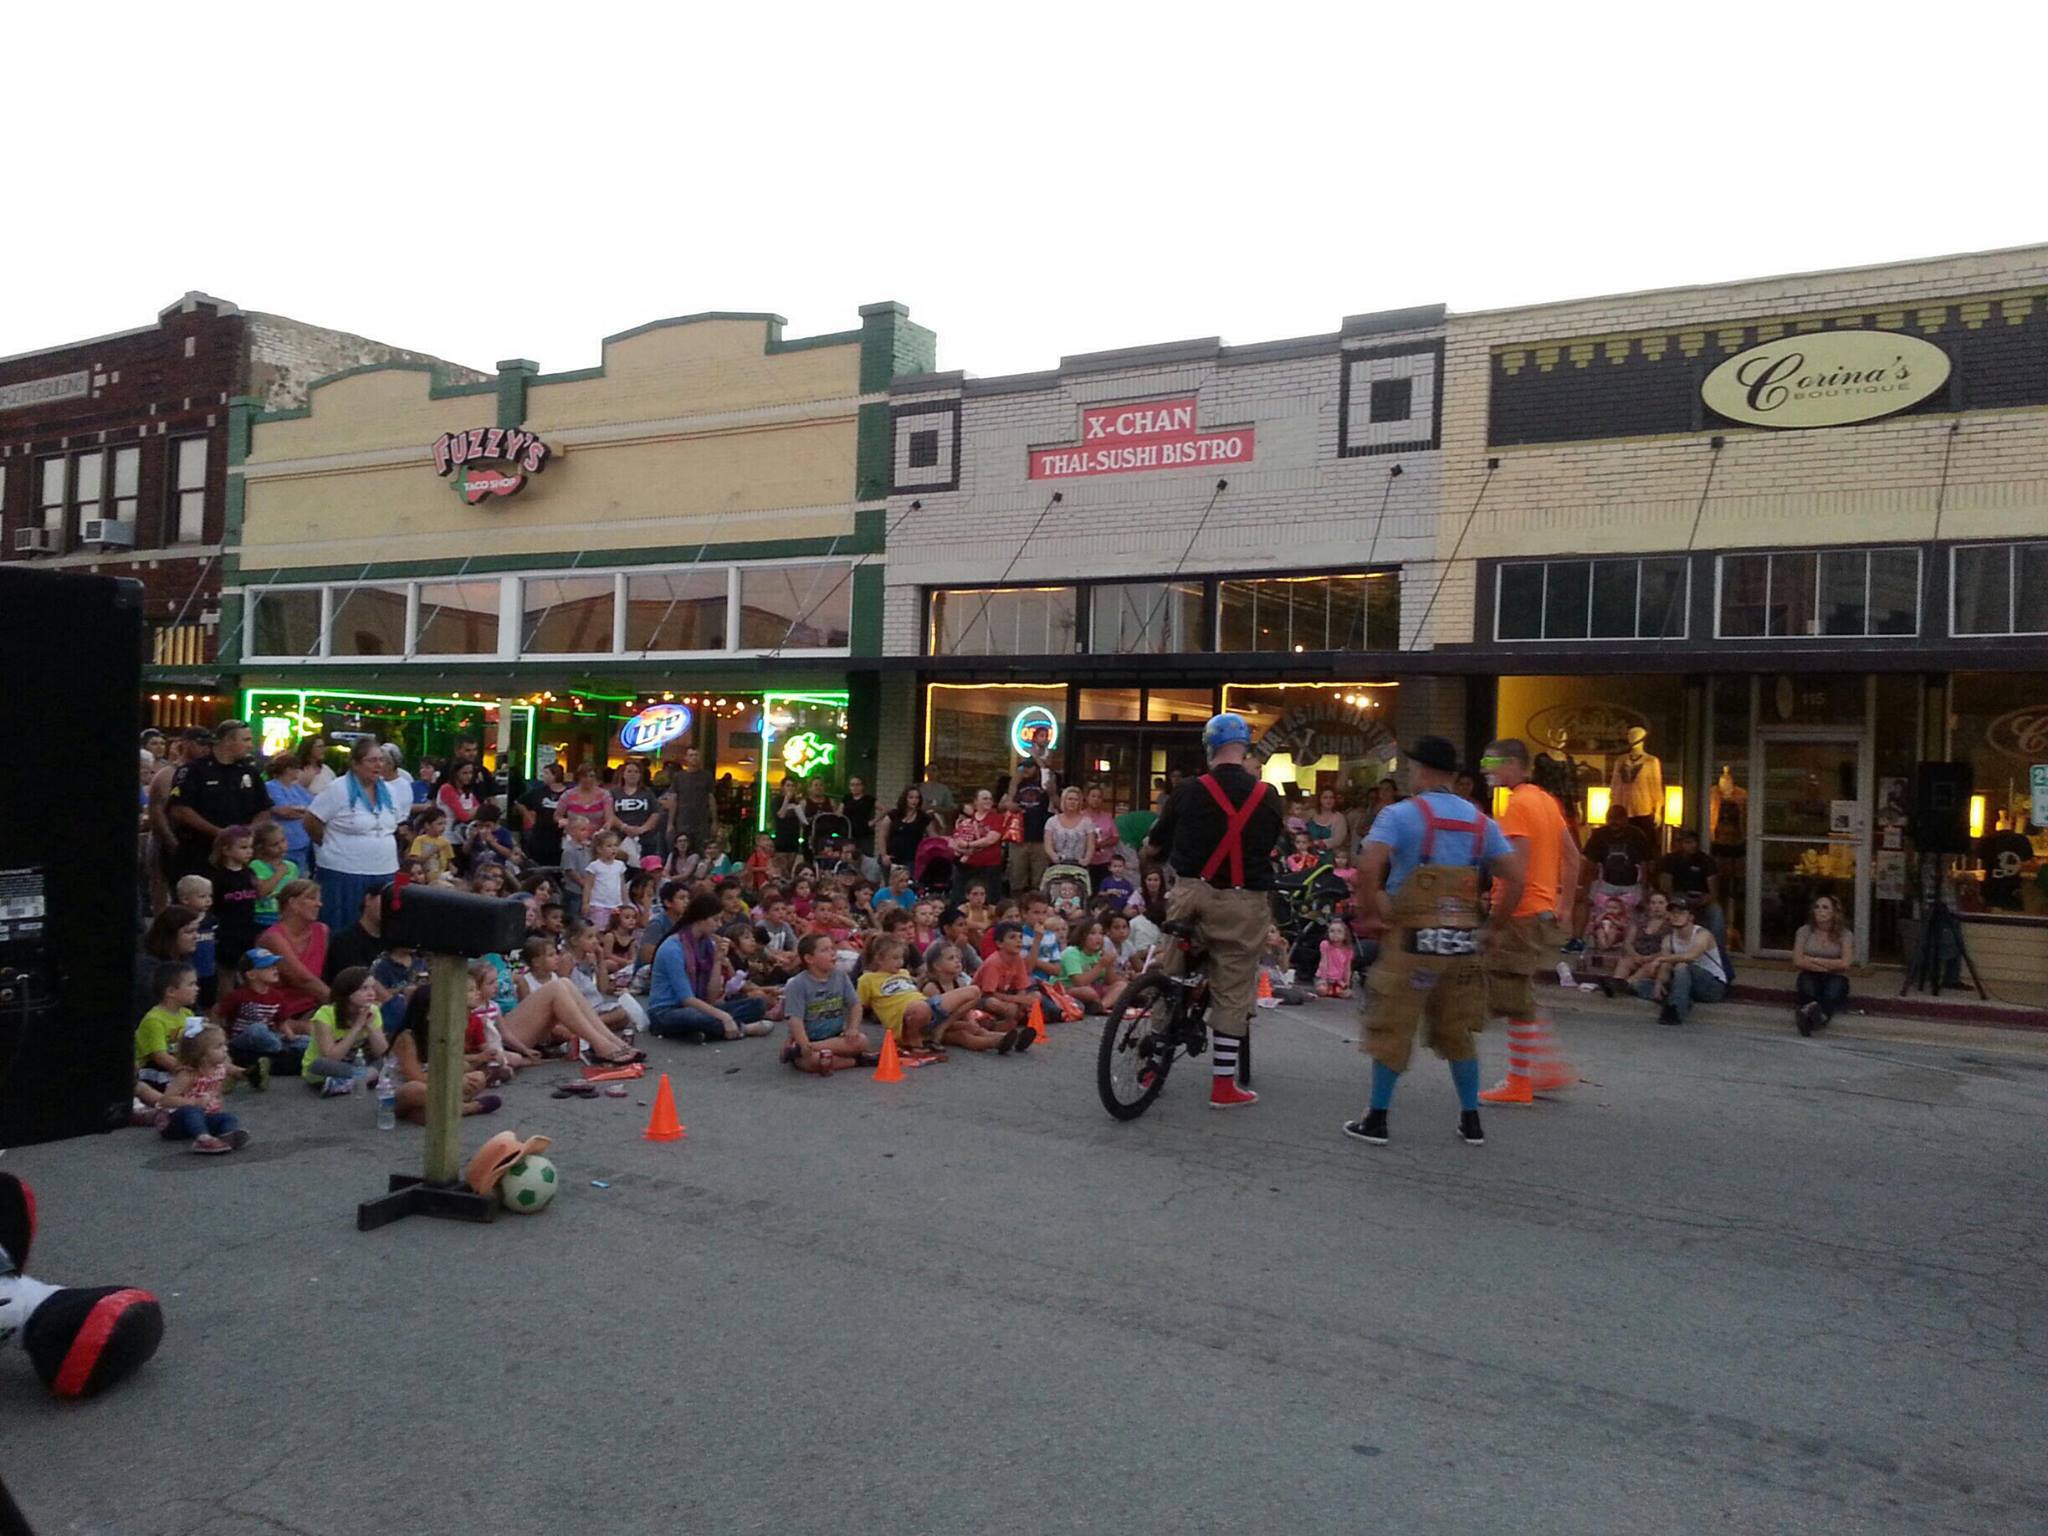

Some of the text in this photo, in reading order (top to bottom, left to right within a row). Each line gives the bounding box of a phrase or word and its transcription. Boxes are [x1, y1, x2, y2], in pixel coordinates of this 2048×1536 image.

[1736, 352, 1911, 412] Corina's
[1794, 382, 1911, 400] BOUTIQUE
[1086, 406, 1193, 440] X-CHAN
[432, 427, 545, 476] FUZZY'S
[1041, 436, 1242, 476] THAI-SUSHI BISTRO
[464, 477, 516, 492] TACO SHOP
